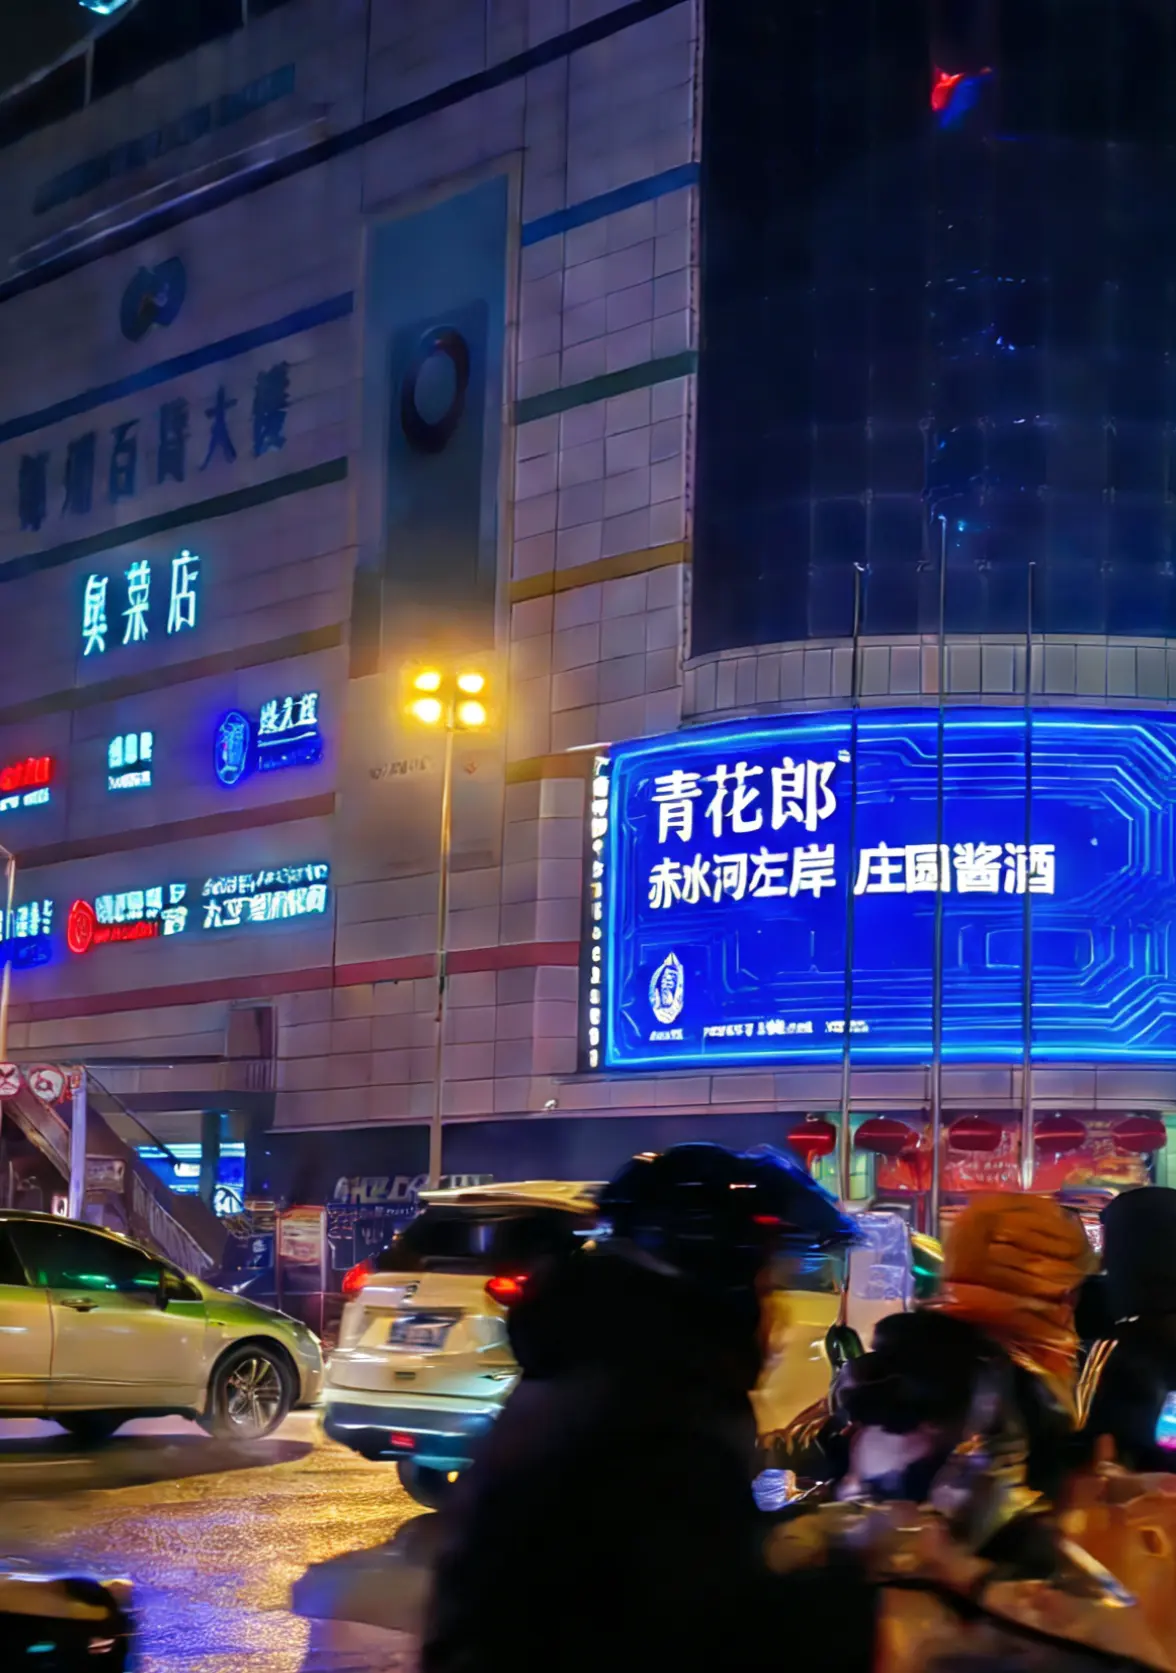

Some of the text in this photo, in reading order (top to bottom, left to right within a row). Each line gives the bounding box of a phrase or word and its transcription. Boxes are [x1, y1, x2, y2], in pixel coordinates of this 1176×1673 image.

[651, 757, 837, 843] 青花郎
[648, 841, 1056, 909] 赤水河左岸 庄园酱酒
